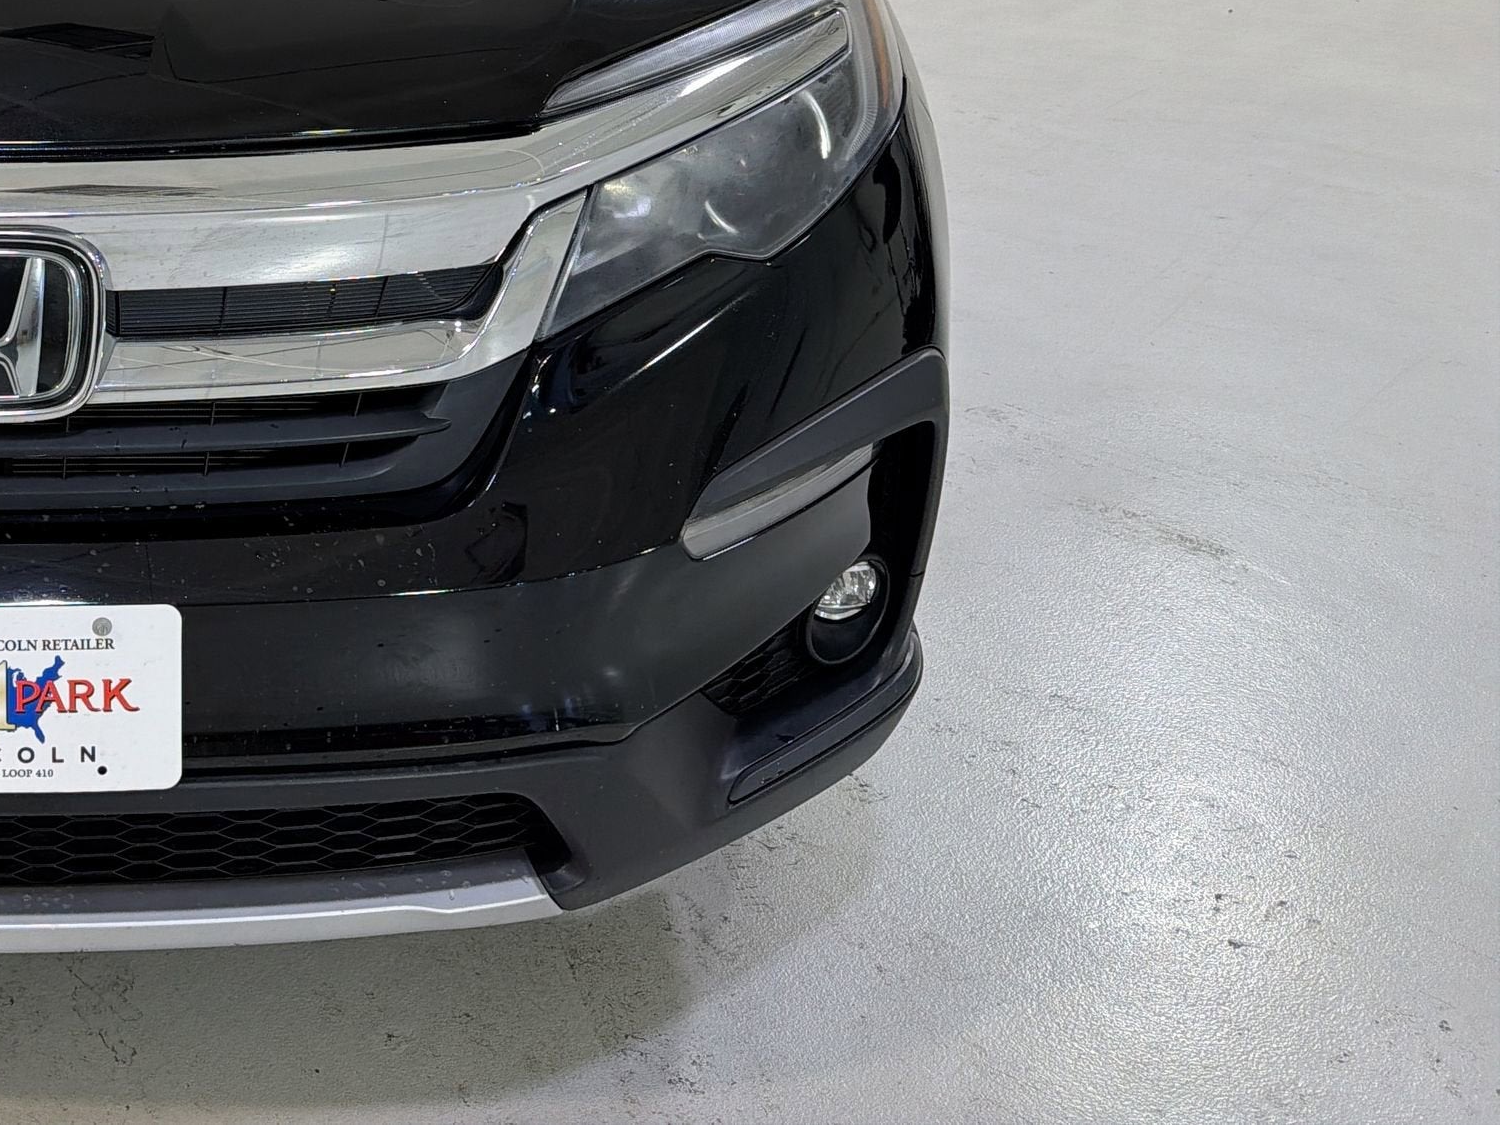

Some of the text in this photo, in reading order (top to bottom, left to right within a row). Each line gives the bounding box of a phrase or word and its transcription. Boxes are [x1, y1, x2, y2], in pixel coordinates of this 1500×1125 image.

[41, 638, 115, 651] RETAILER
[15, 678, 140, 714] PARK
[2, 768, 33, 778] LOOP
[35, 768, 54, 778] 410
